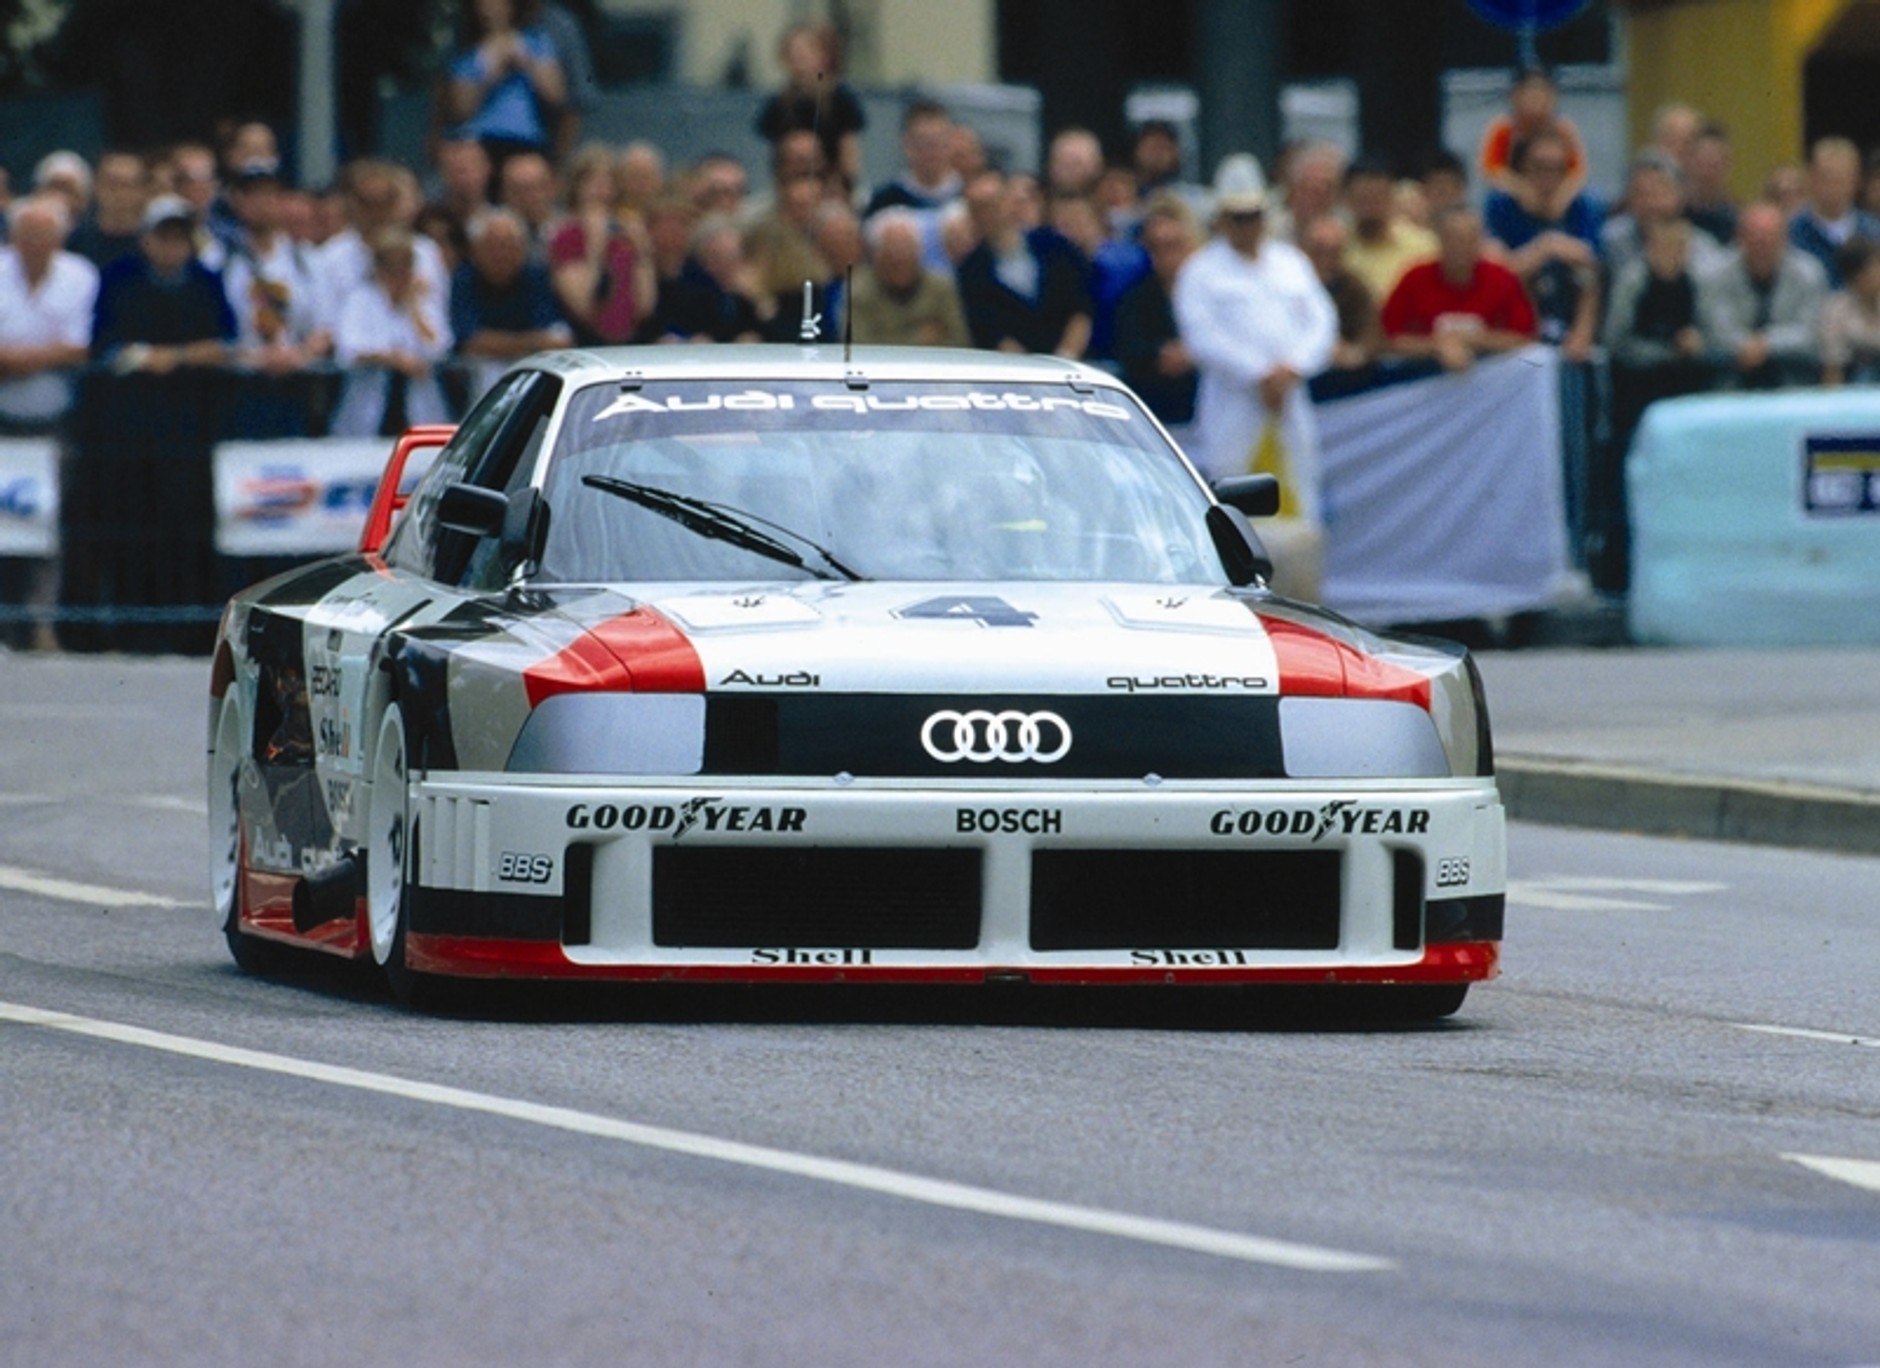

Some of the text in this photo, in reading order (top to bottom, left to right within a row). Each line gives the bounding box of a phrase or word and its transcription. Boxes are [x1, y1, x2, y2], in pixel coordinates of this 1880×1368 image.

[592, 391, 1131, 421] Audi quattro
[889, 595, 1040, 629] 4
[719, 668, 820, 687] Audi
[1106, 673, 1268, 693] quattro
[956, 807, 1062, 834] BOSCH
[499, 853, 553, 884] BBS
[1435, 856, 1470, 888] BBS
[752, 948, 872, 965] Shell
[1131, 949, 1248, 965] Shell
